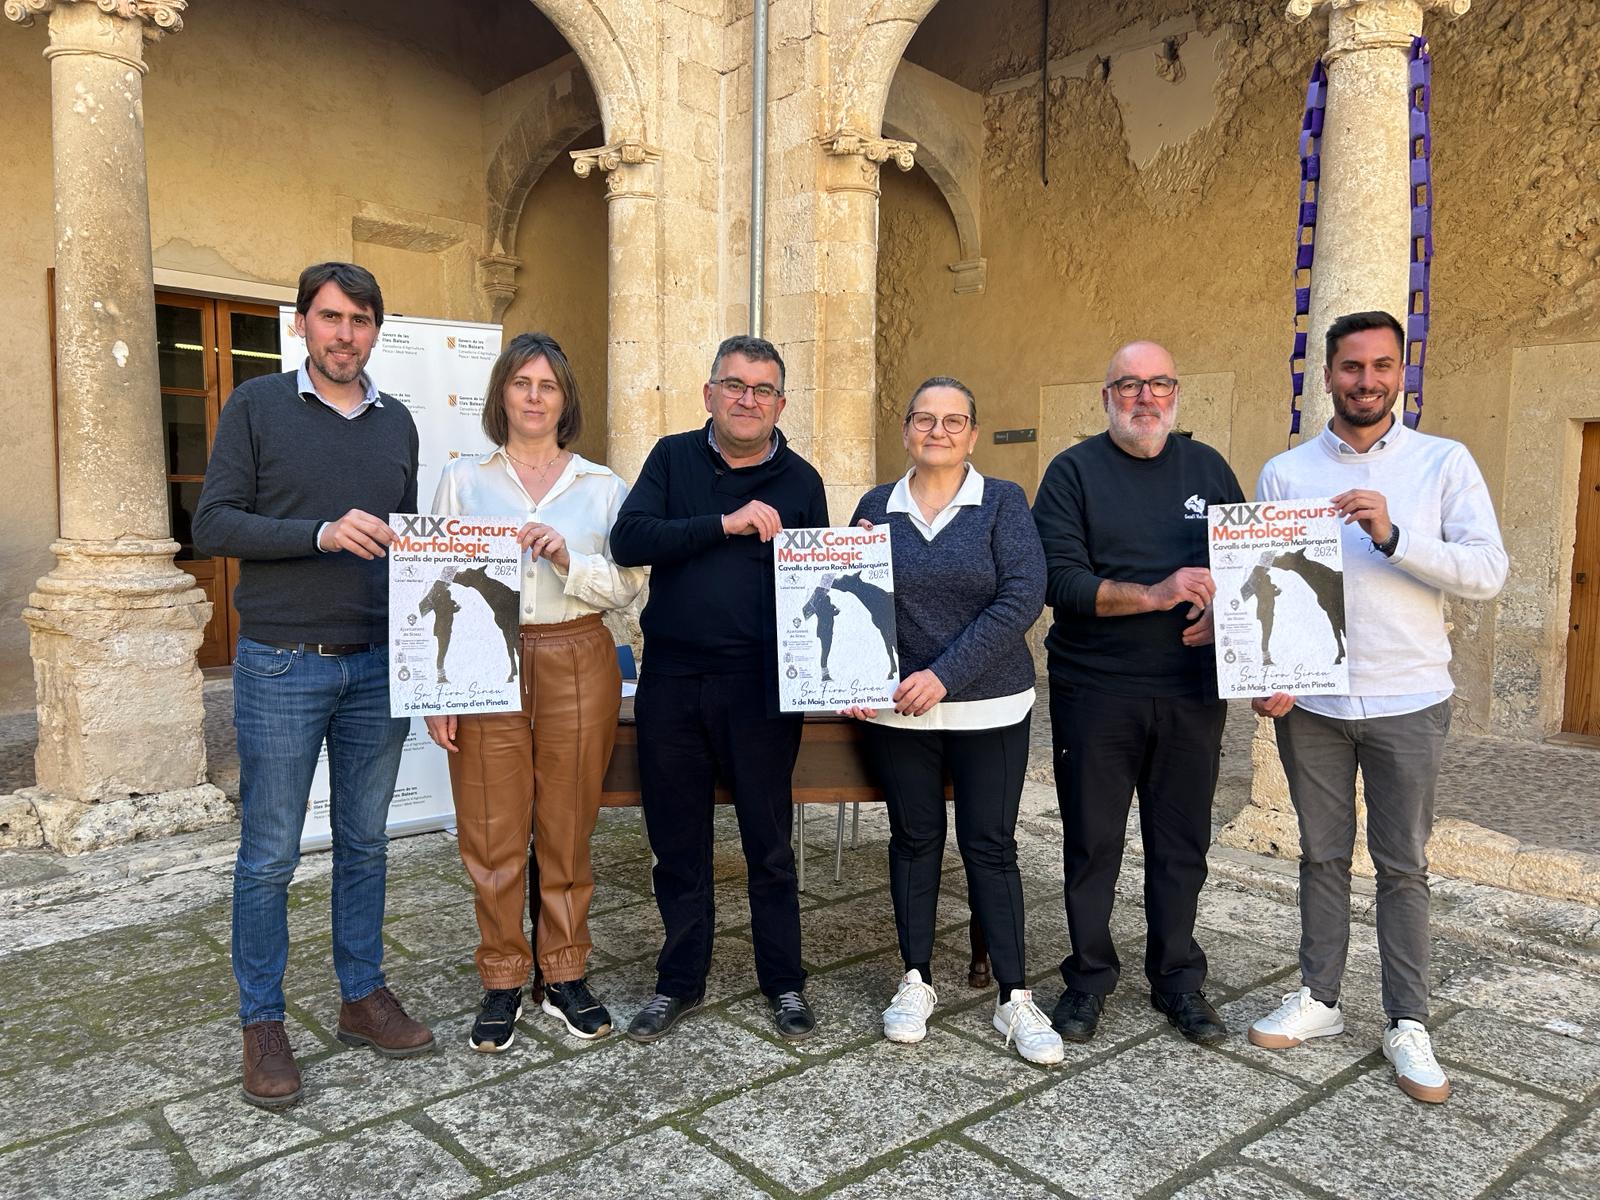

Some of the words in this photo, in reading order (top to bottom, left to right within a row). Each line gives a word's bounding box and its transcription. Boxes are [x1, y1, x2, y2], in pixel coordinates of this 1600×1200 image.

[1218, 504, 1262, 526] XIX
[1262, 506, 1336, 521] Concurs
[400, 516, 446, 537] XIX
[446, 520, 518, 537] Concurs
[1212, 521, 1307, 542] Morfològic
[783, 530, 823, 549] XIX
[823, 532, 887, 546] Concurs
[1291, 538, 1337, 546] Mallorquina
[392, 536, 489, 557] Morfològic
[1314, 546, 1337, 557] 2024
[453, 556, 472, 564] Raça
[473, 555, 517, 564] Mallorquina
[778, 547, 862, 565] Morfològic
[494, 565, 517, 576] 2024
[848, 562, 889, 570] Mallorquina
[868, 569, 889, 580] 2024
[1248, 683, 1266, 692] Maig
[1271, 683, 1293, 691] Camp
[422, 702, 441, 710] Maig
[446, 700, 468, 709] Camp
[808, 698, 825, 706] Maig
[830, 697, 850, 705] Camp
